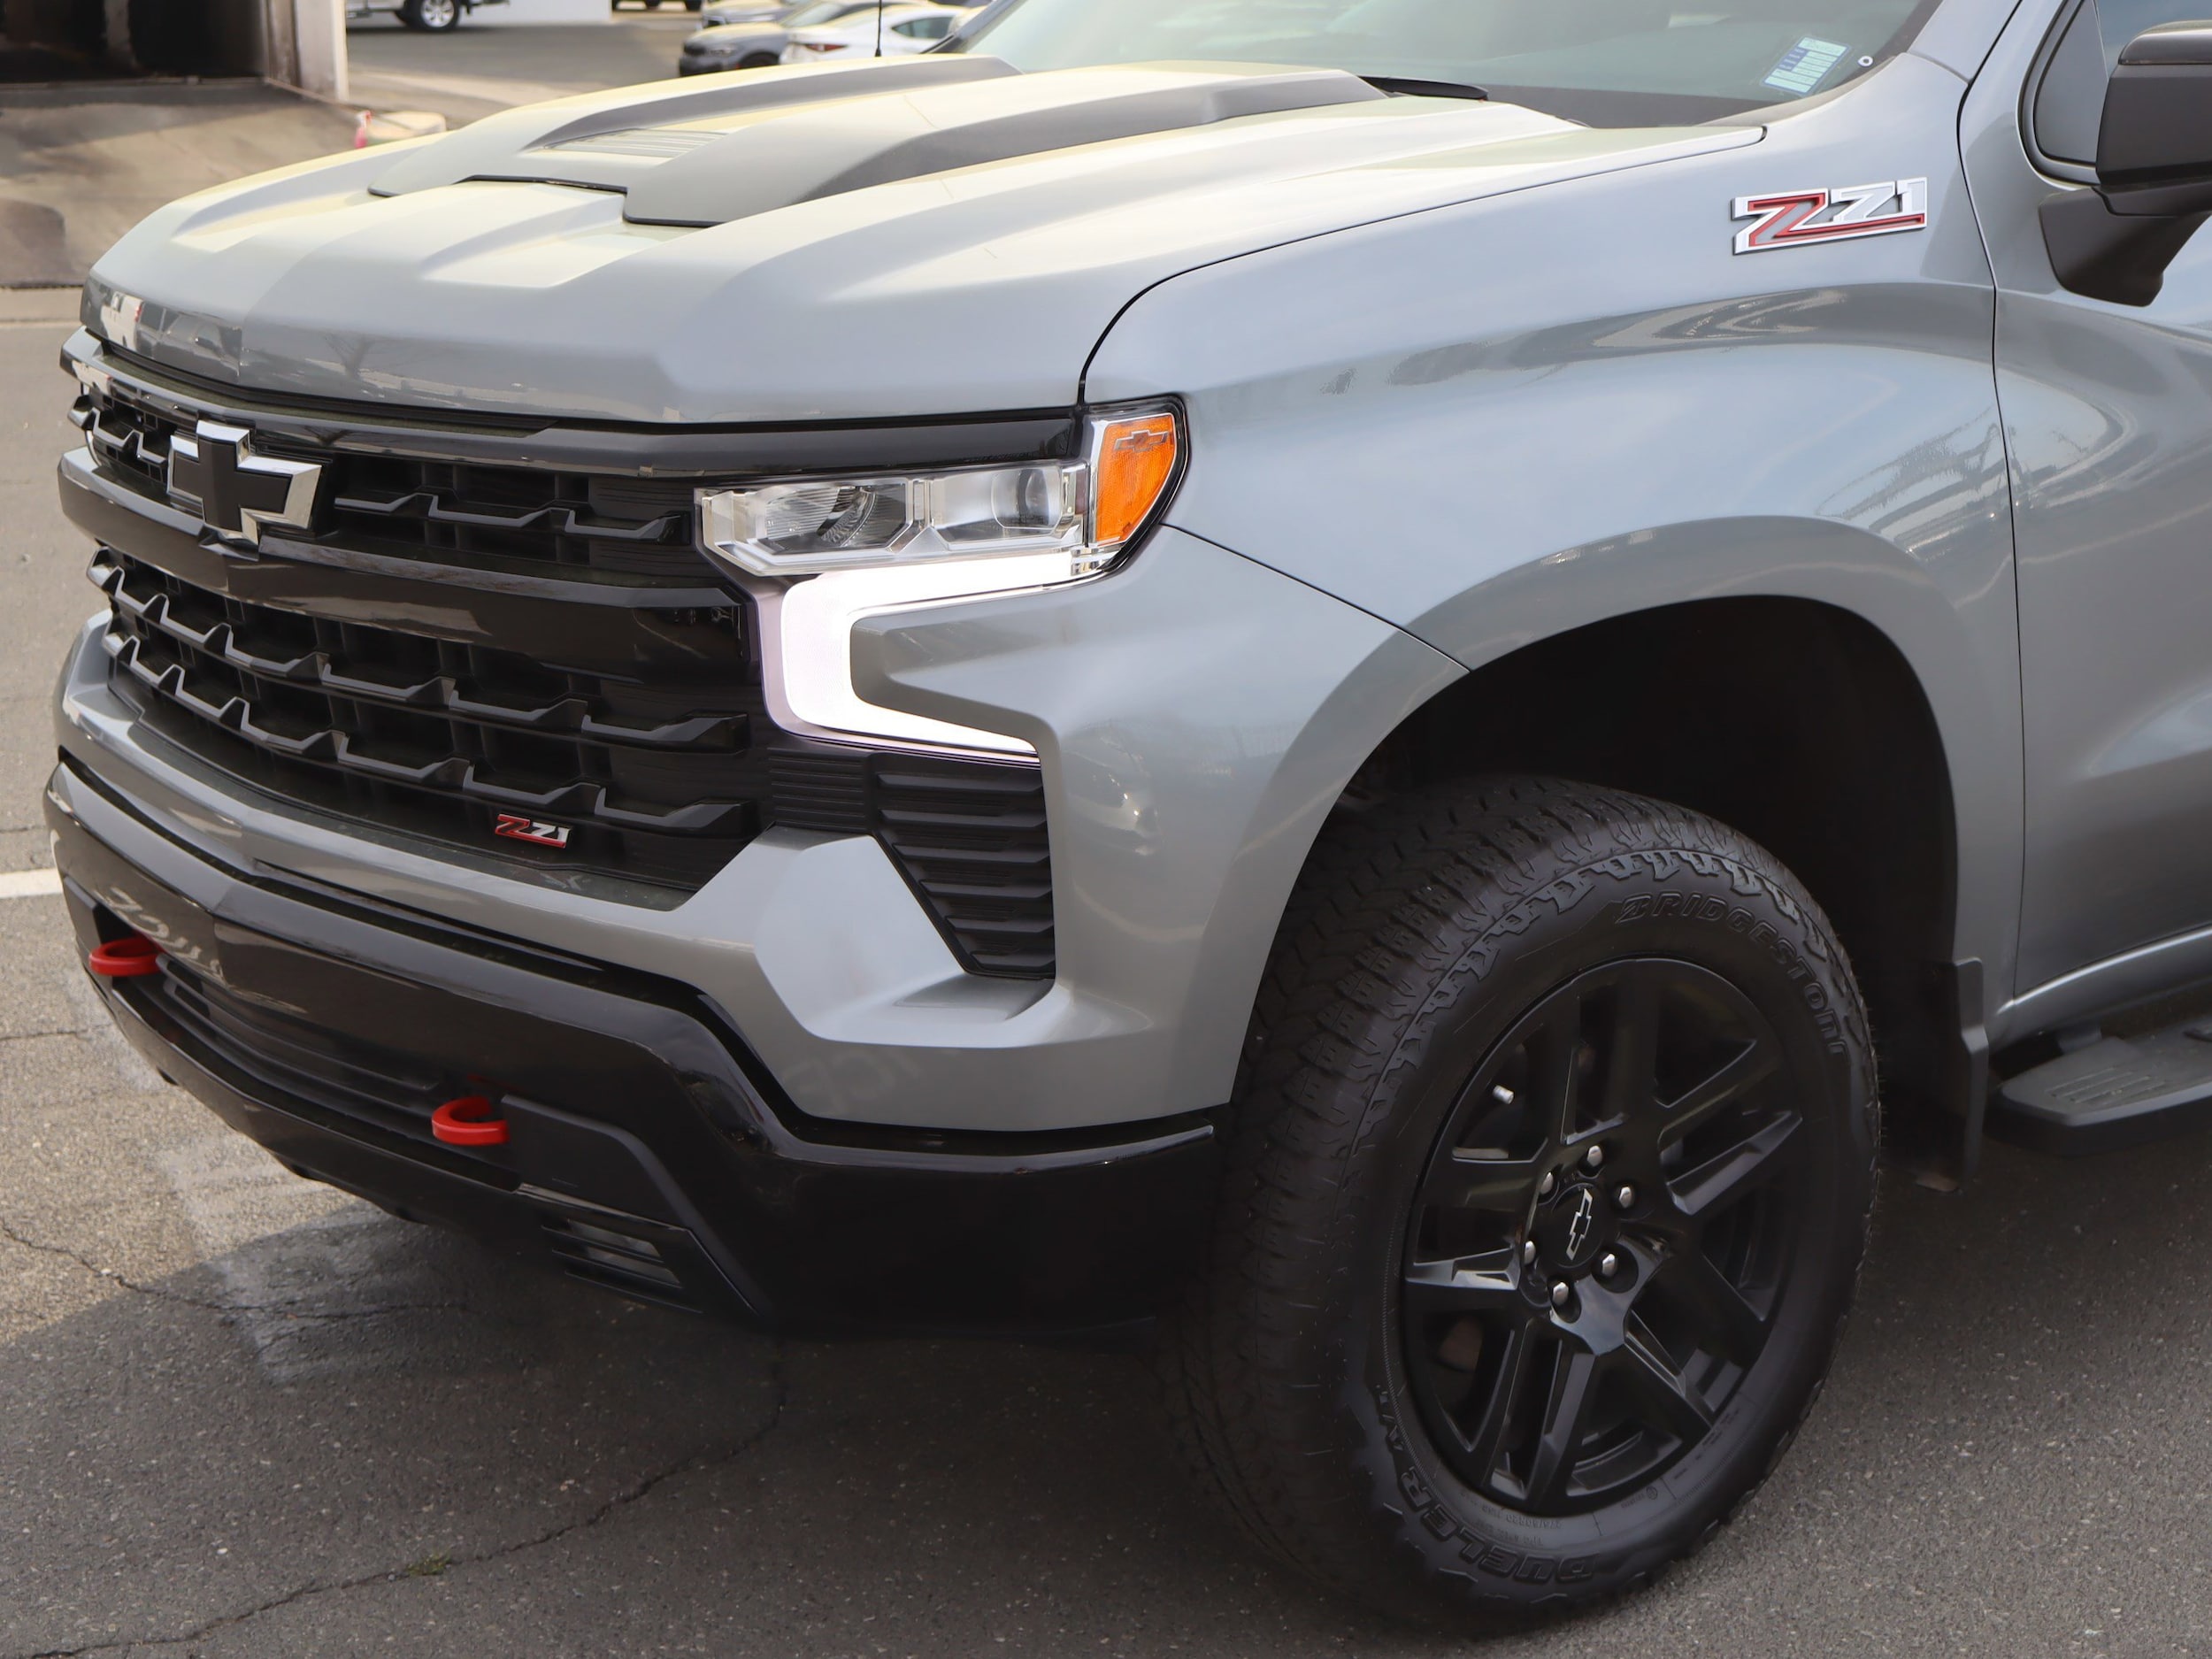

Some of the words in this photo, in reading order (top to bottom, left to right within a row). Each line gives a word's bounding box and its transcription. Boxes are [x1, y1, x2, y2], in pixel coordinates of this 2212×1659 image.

[1732, 177, 1927, 255] Z71
[495, 814, 571, 849] Z71
[1401, 1465, 1598, 1582] DUELER
